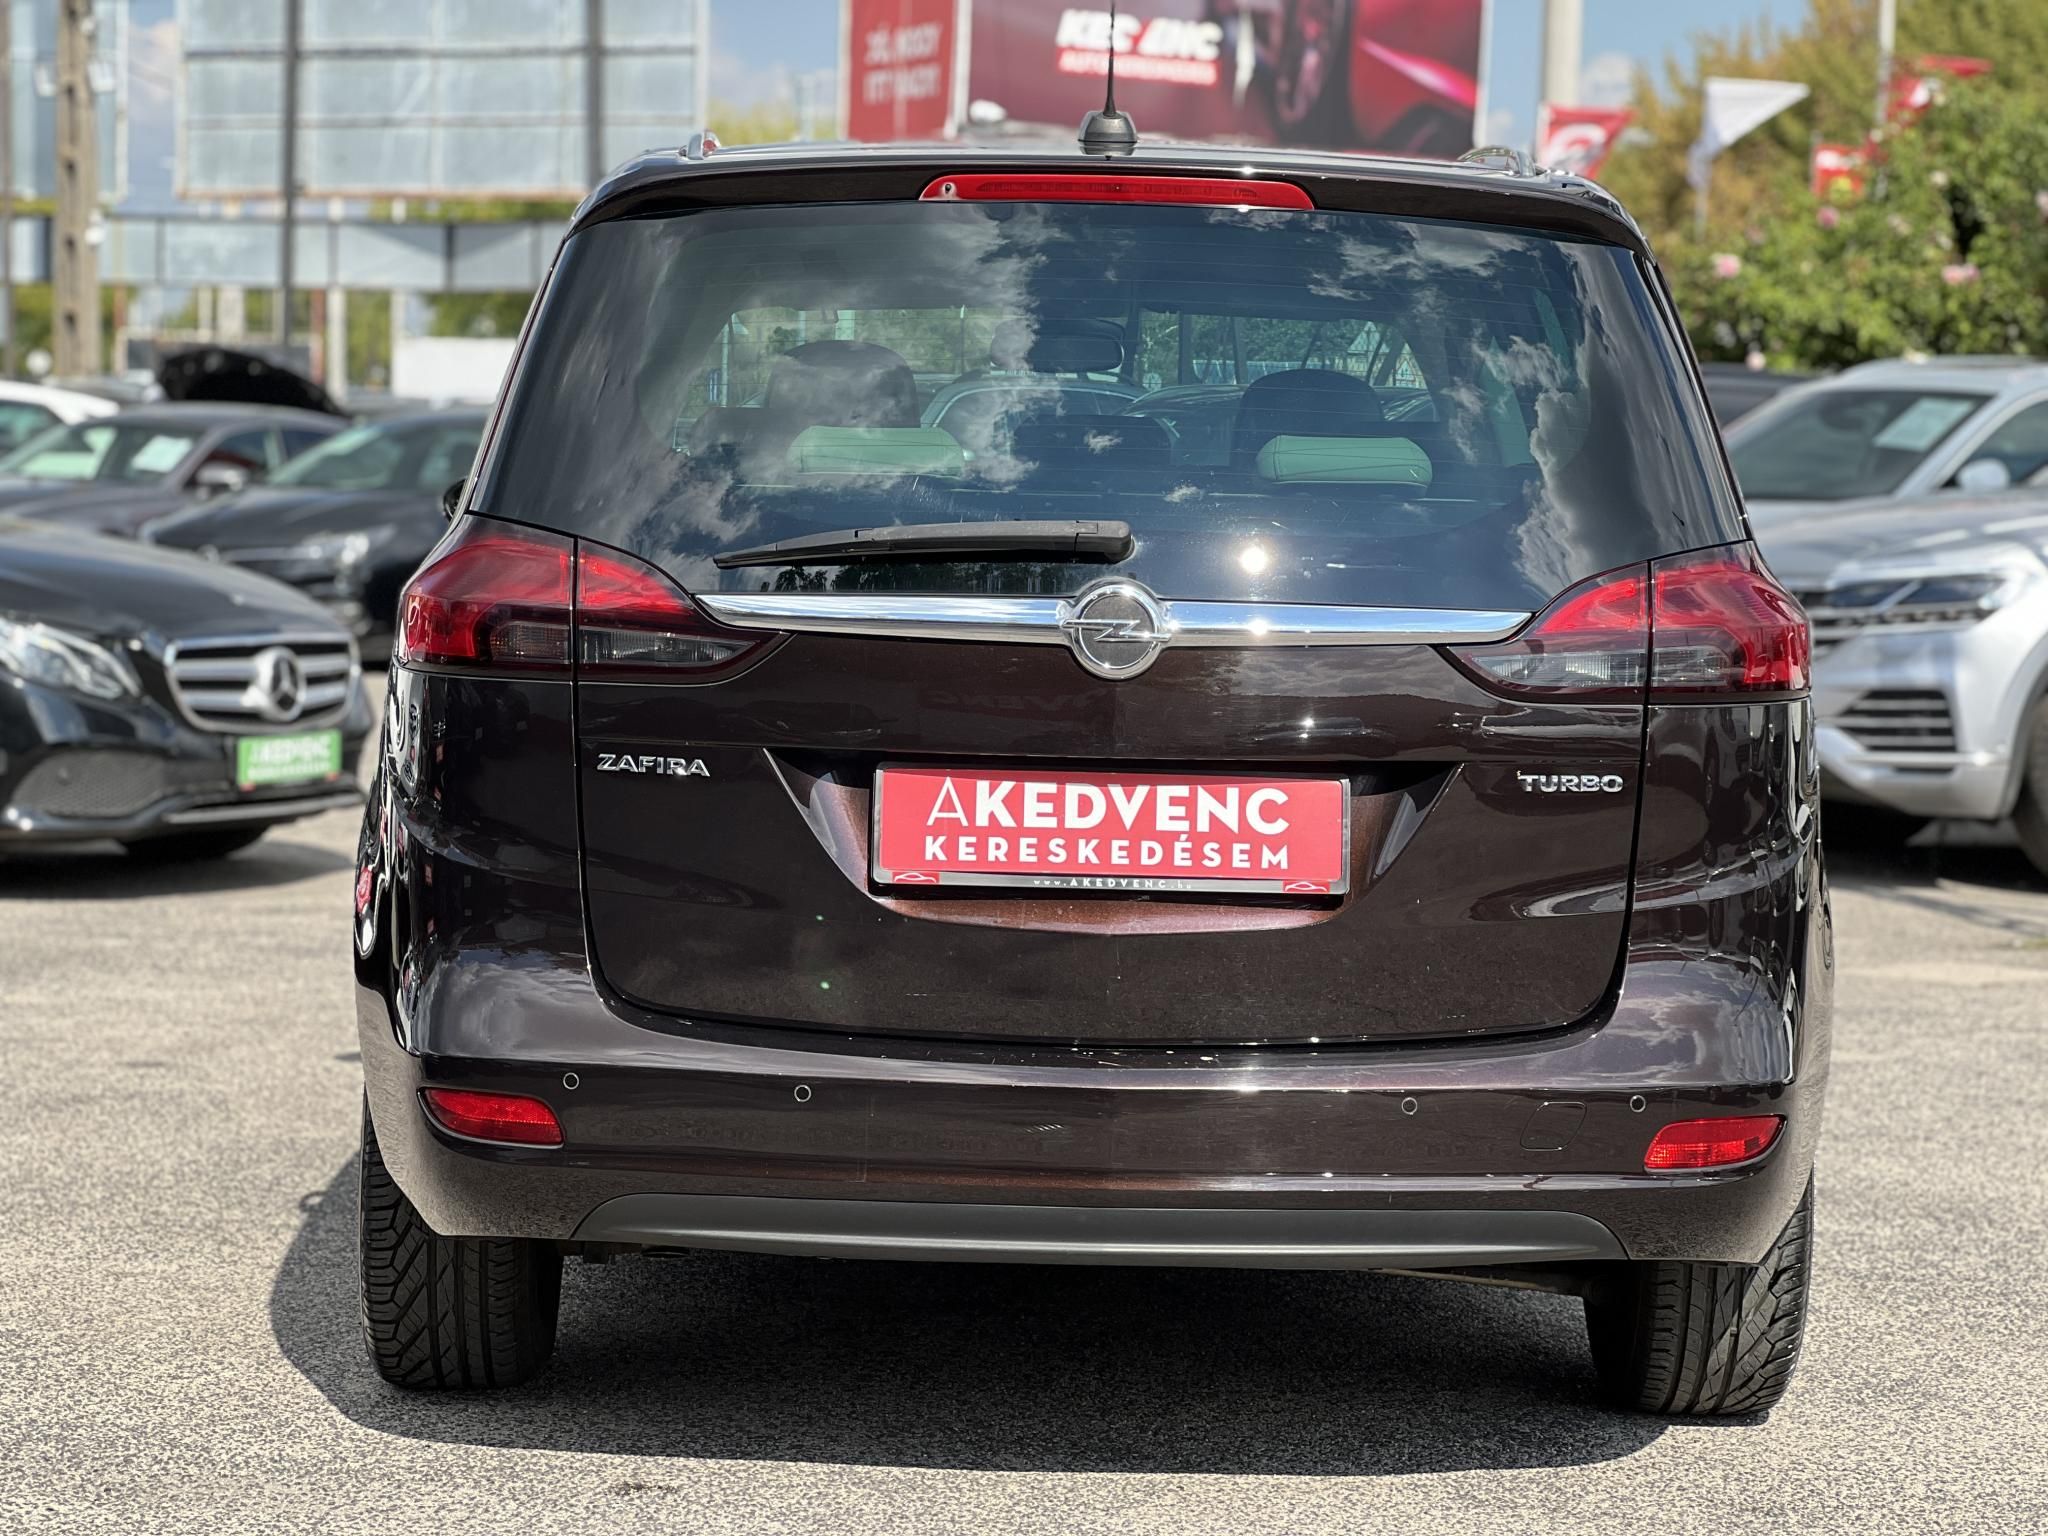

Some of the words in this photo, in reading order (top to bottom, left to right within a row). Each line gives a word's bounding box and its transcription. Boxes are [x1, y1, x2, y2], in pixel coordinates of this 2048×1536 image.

[597, 753, 711, 777] ZAFIRA
[1518, 774, 1624, 793] TURBO
[926, 776, 1289, 835] AKEDVENC
[925, 834, 1289, 869] KERESKEDÉSEM
